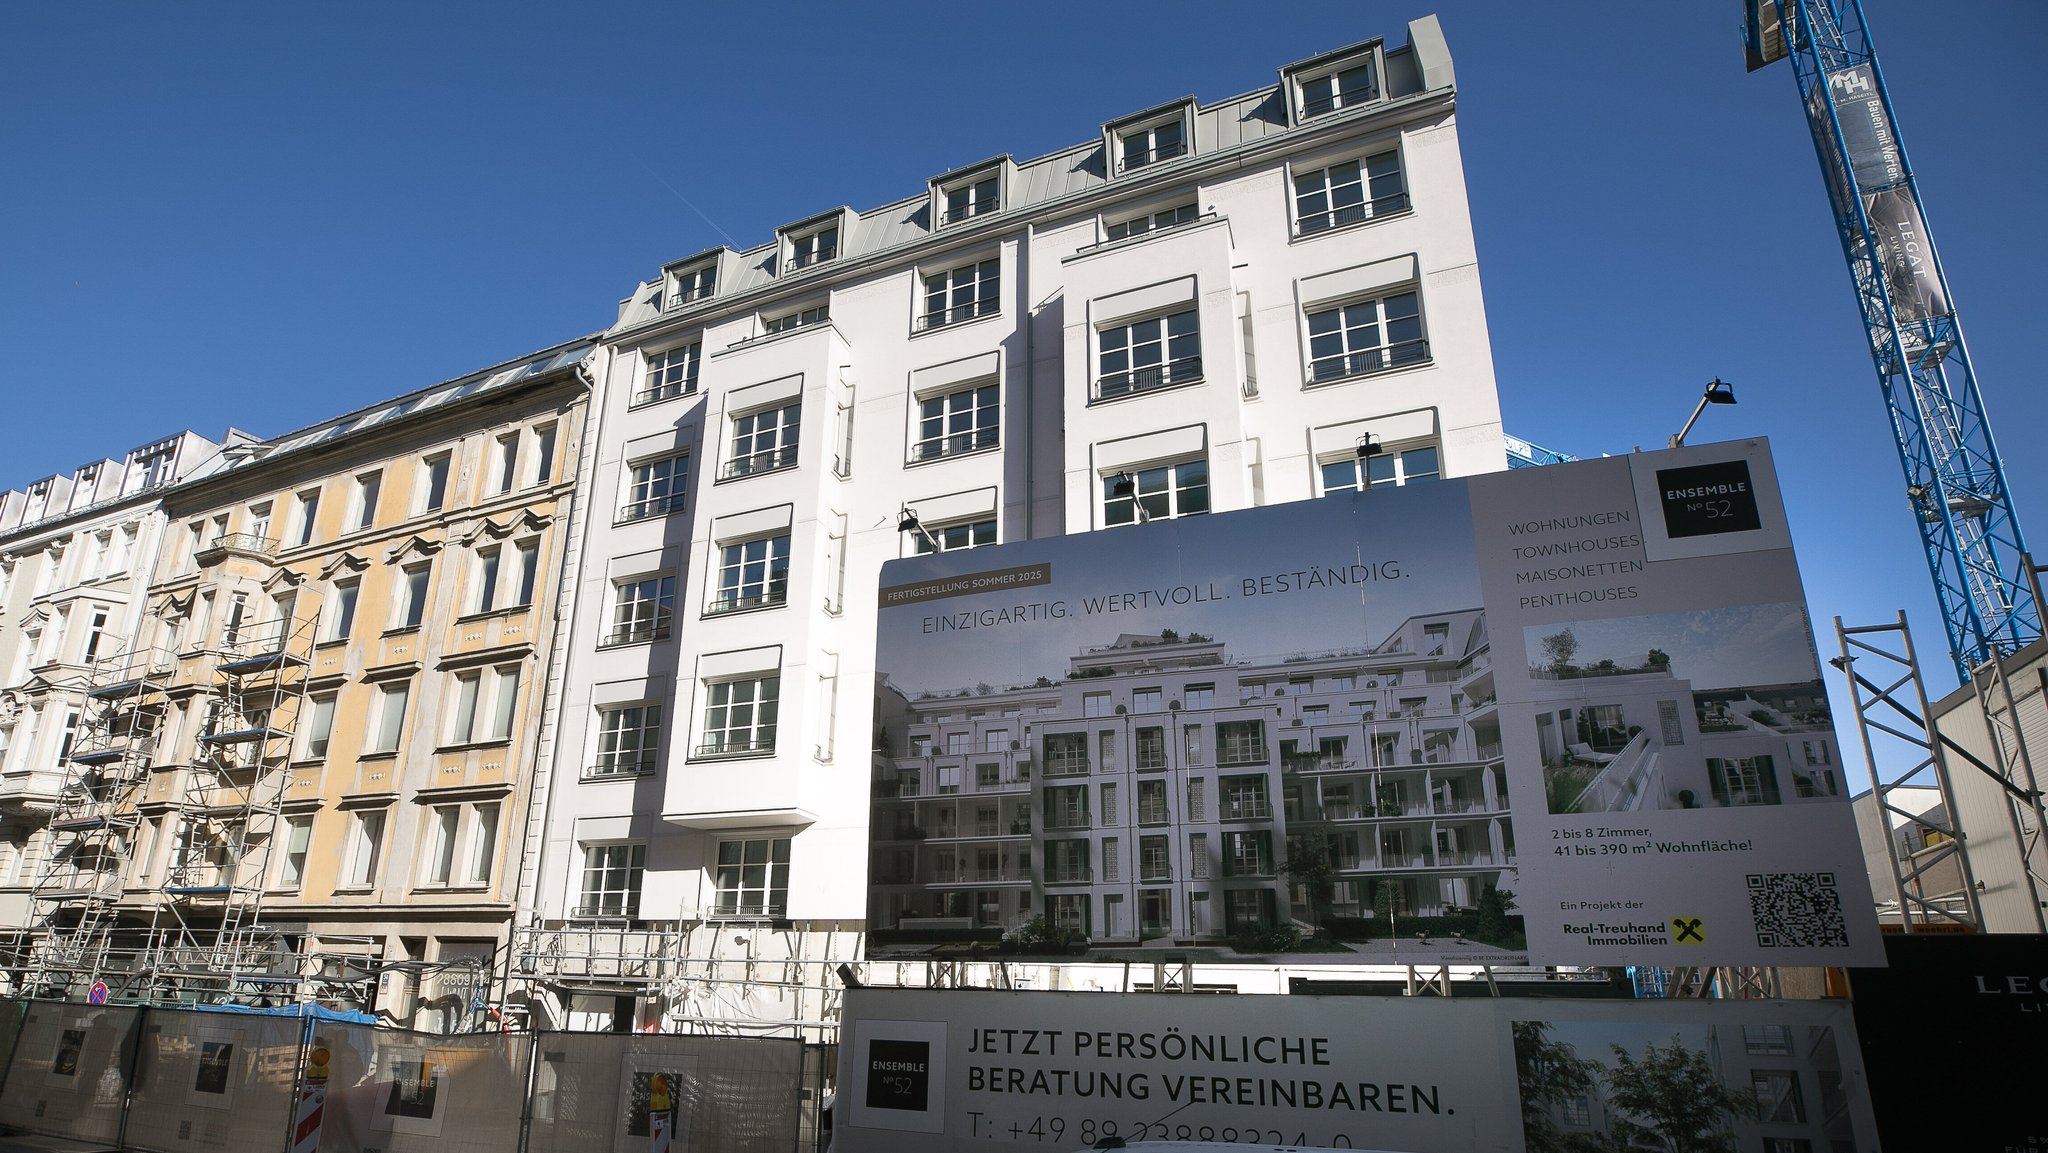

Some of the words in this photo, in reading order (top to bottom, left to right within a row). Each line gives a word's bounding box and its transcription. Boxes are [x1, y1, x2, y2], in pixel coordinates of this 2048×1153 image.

[1867, 100, 1884, 128] Bauen
[1876, 129, 1891, 145] mit
[1881, 145, 1899, 182] Werten.
[1890, 235, 1906, 268] LIVING
[1897, 221, 1927, 278] LEGAT
[1667, 482, 1747, 500] ENSEMBLE
[1706, 500, 1734, 518] 52
[1508, 510, 1630, 536] WOHNUNGEN
[1512, 534, 1640, 560] TOWNHOUSES
[1516, 560, 1643, 584] MAISONETTEN
[887, 580, 969, 602] FERTIGSTELLUNG
[971, 573, 1016, 590] SOMMER
[1017, 569, 1043, 582] 2025
[922, 601, 1074, 635] EINZIGARTIG.
[1083, 584, 1231, 616] WERTVOLL.
[1242, 560, 1412, 598] BESTÄNDIG.
[1520, 586, 1638, 609] PENTHOUSES
[1552, 829, 1560, 839] 2
[1563, 828, 1582, 839] bis
[1585, 828, 1594, 838] 8
[1598, 826, 1652, 840] Zimmer,
[1554, 846, 1570, 857] 41
[1576, 844, 1596, 856] bis
[1600, 843, 1628, 855] 390
[1632, 841, 1653, 855] m²
[1655, 839, 1753, 853] Wohnfläche!
[1560, 901, 1578, 910] Ein
[1580, 900, 1621, 912] Projekt
[1625, 900, 1644, 910] der
[1563, 922, 1666, 935] Real-Treuhand
[1587, 934, 1668, 946] Immobilien
[2020, 1002, 2048, 1013] LI
[968, 1028, 1062, 1057] JETZT
[1074, 1028, 1331, 1066] PERSÖNLICHE
[872, 1061, 925, 1072] ENSEMBLE
[894, 1077, 912, 1094] 52
[968, 1067, 1150, 1101] BERATUNG
[1163, 1075, 1456, 1116] VEREINBAREN.
[967, 1111, 992, 1138] T:
[1008, 1116, 1065, 1143] +49
[1081, 1119, 1118, 1145] 89
